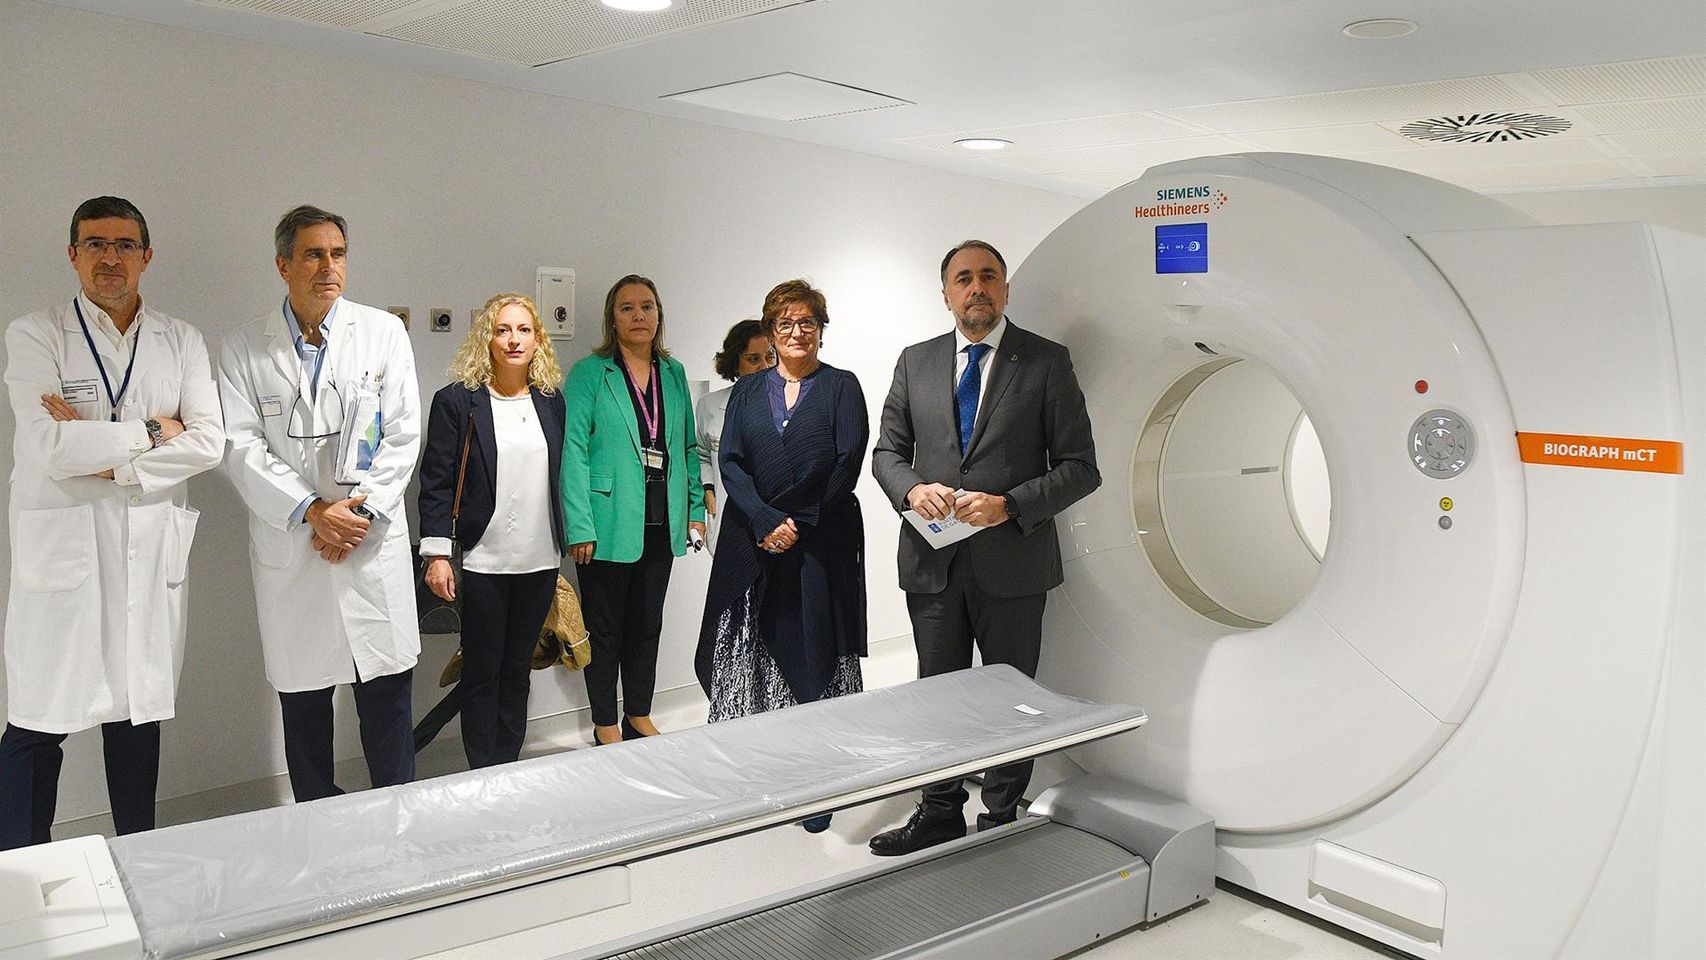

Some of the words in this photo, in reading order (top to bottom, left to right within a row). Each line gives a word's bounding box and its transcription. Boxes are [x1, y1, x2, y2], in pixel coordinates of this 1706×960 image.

[1157, 186, 1210, 201] SIEMENS
[1135, 202, 1210, 218] Healthineers
[1544, 442, 1619, 460] BIOGRAPH
[1623, 448, 1657, 462] mCT
